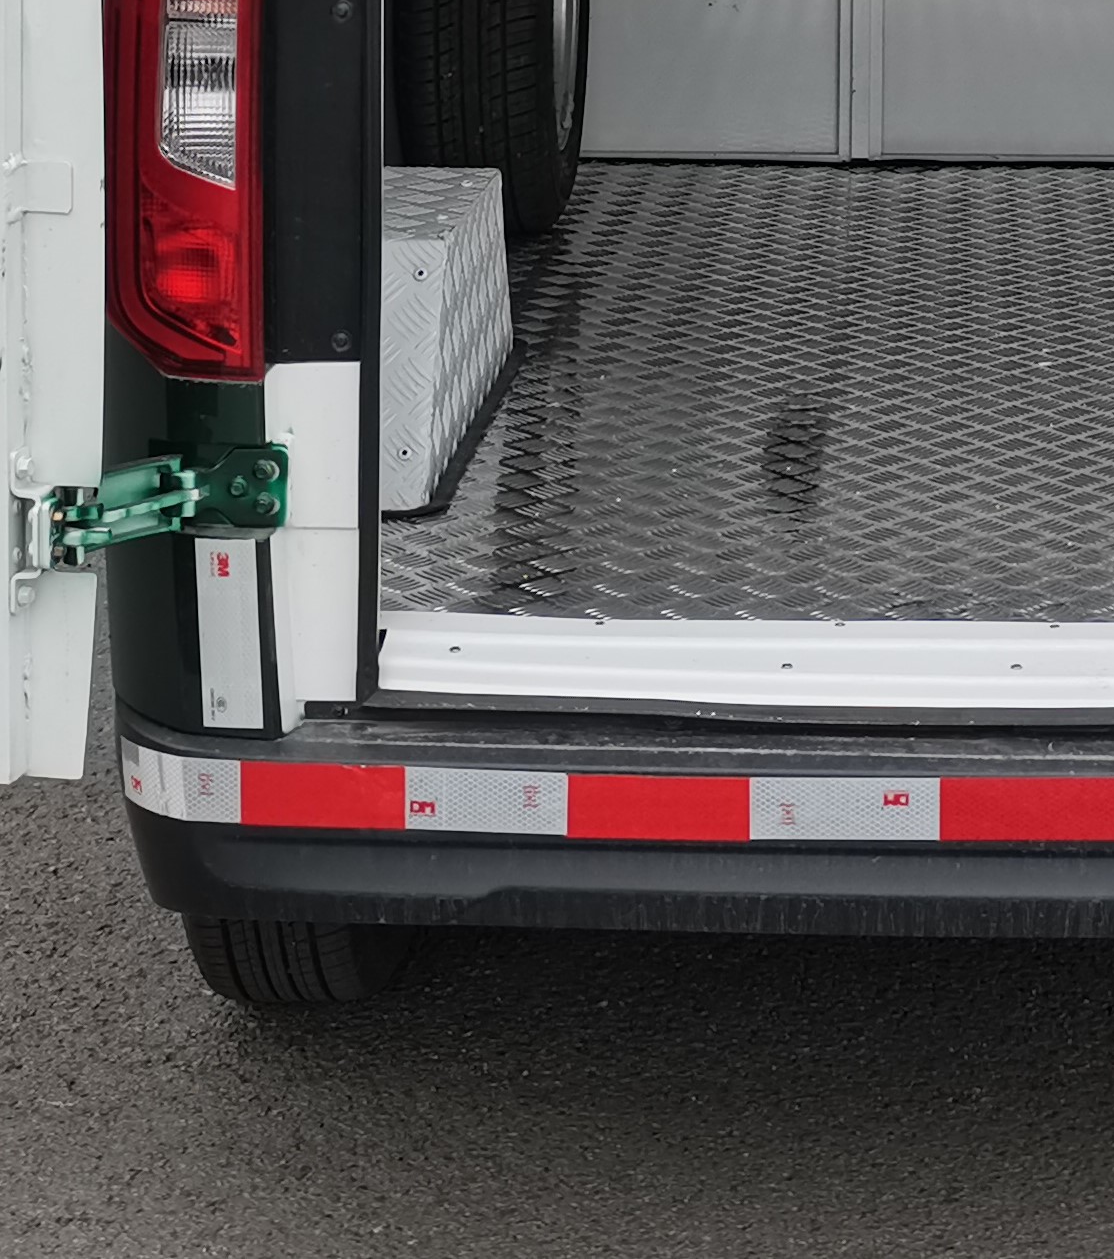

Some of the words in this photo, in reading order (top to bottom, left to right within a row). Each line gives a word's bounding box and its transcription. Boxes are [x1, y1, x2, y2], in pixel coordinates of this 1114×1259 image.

[217, 552, 230, 577] 3M
[884, 793, 910, 807] DM
[409, 801, 436, 814] DM
